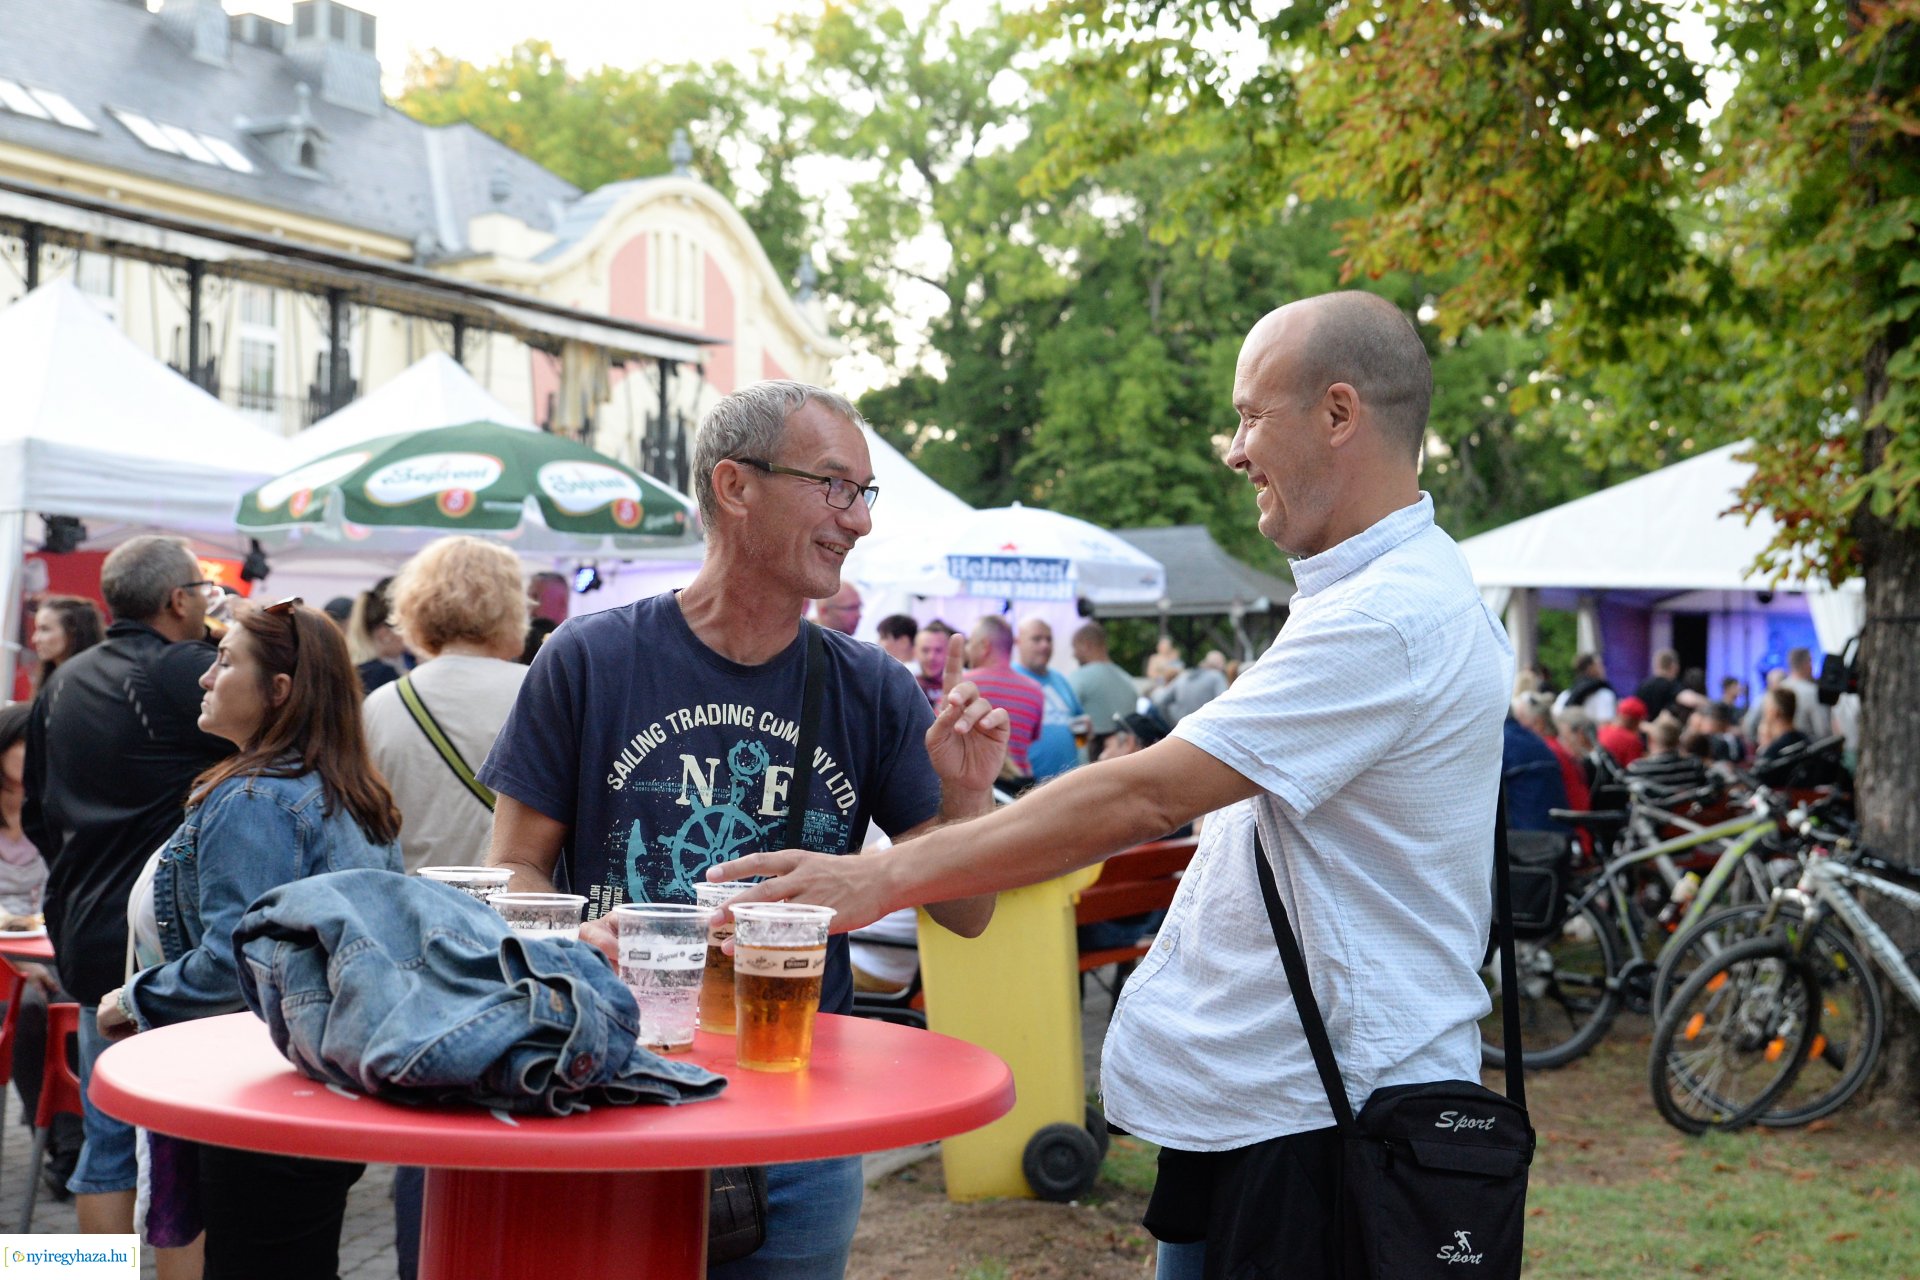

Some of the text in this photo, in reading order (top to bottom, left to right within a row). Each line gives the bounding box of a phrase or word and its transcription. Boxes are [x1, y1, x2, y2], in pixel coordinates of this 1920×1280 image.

[951, 557, 1064, 580] Heineken
[606, 703, 857, 816] SAILING TRADING COMNY LTD.
[590, 885, 601, 900] HOT
[1434, 1111, 1496, 1132] Sport
[1436, 1245, 1483, 1265] Sport
